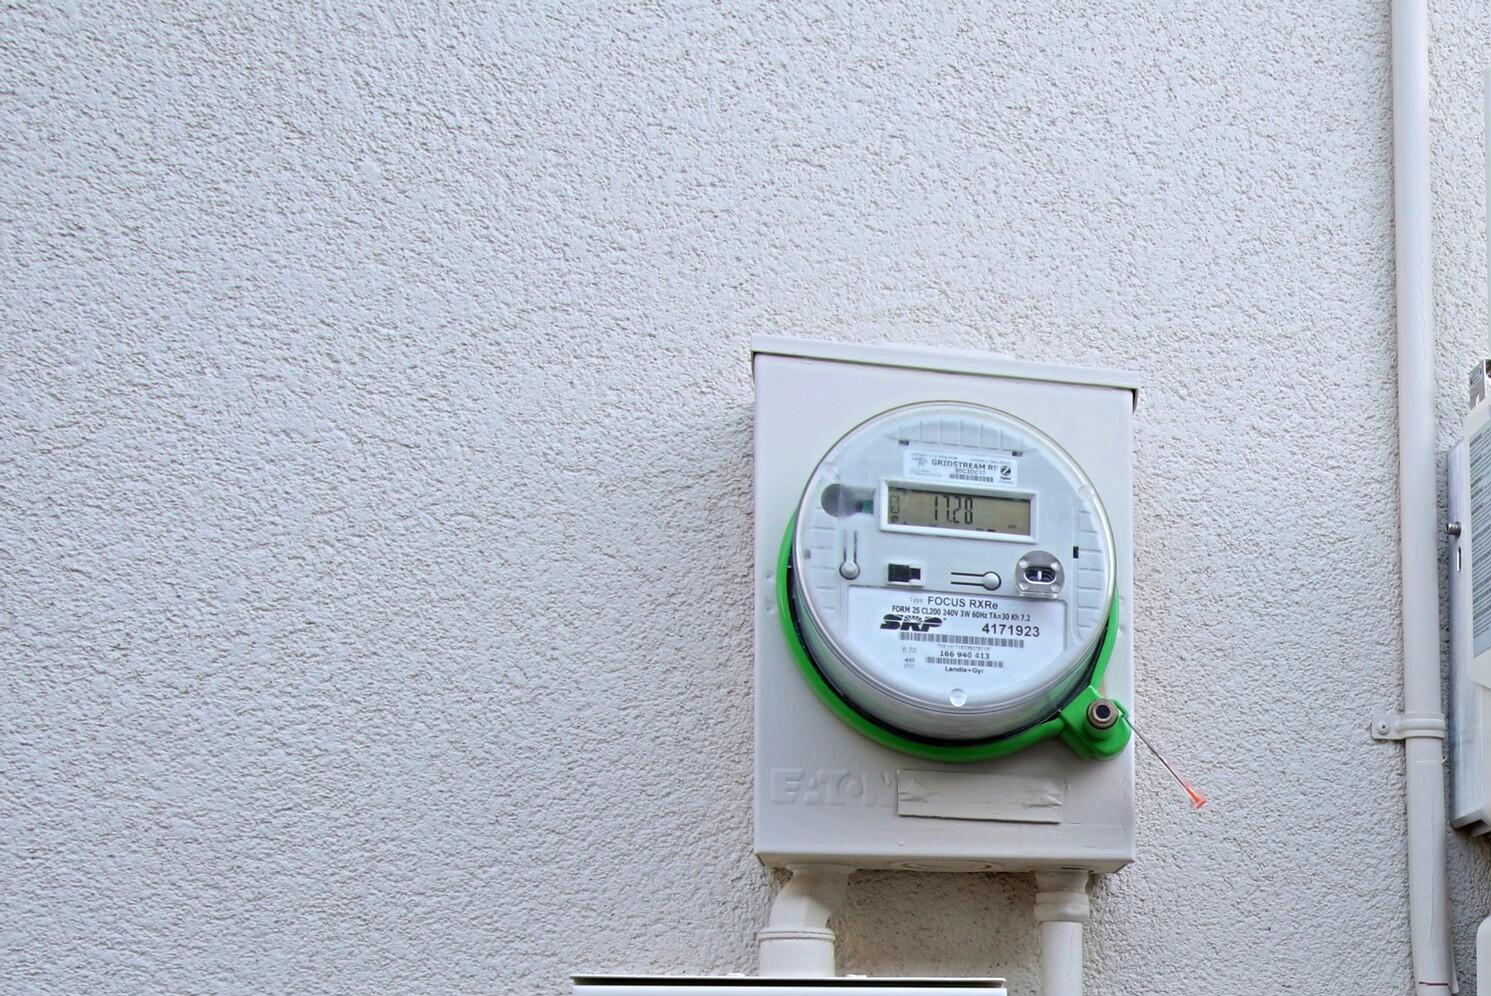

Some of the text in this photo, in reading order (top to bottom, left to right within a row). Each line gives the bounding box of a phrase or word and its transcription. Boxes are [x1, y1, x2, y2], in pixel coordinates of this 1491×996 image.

[932, 459, 986, 470] GRIDSTREAM
[928, 596, 966, 608] FOCUS
[970, 600, 998, 610] RXRe
[892, 605, 910, 614] FORM
[921, 607, 941, 616] CL200
[943, 608, 958, 617] 240V
[972, 611, 987, 619] 60Hz
[989, 612, 1010, 620] TA=30
[1011, 613, 1019, 621] Kh
[1020, 614, 1030, 622] 7.2
[880, 614, 942, 632] SRP
[982, 623, 1040, 637] 4171923
